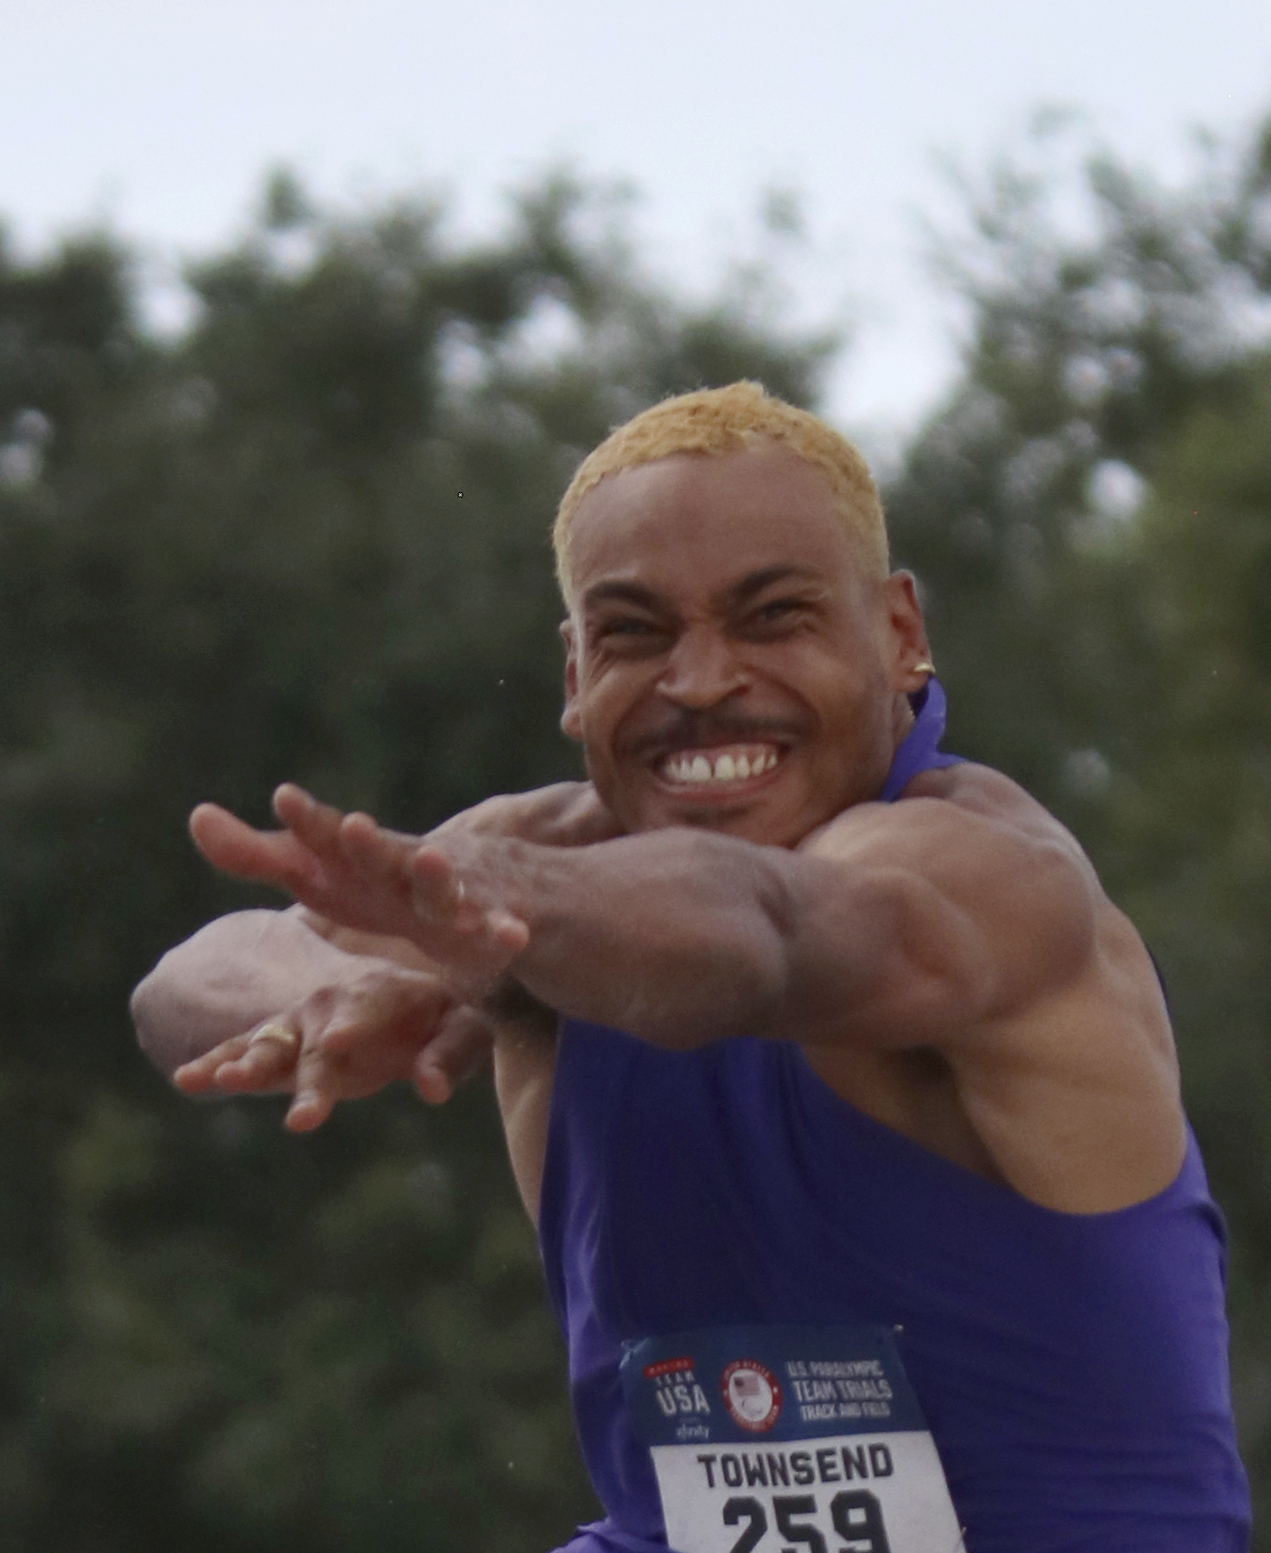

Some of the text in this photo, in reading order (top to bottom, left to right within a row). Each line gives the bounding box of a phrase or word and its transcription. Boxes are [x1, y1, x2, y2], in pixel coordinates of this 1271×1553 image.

[654, 1370, 696, 1386] TEAM
[656, 1384, 711, 1417] USA
[792, 1379, 893, 1402] TEAM TRIALS
[800, 1404, 837, 1421] TRACK
[697, 1441, 893, 1489] TOWNSEND
